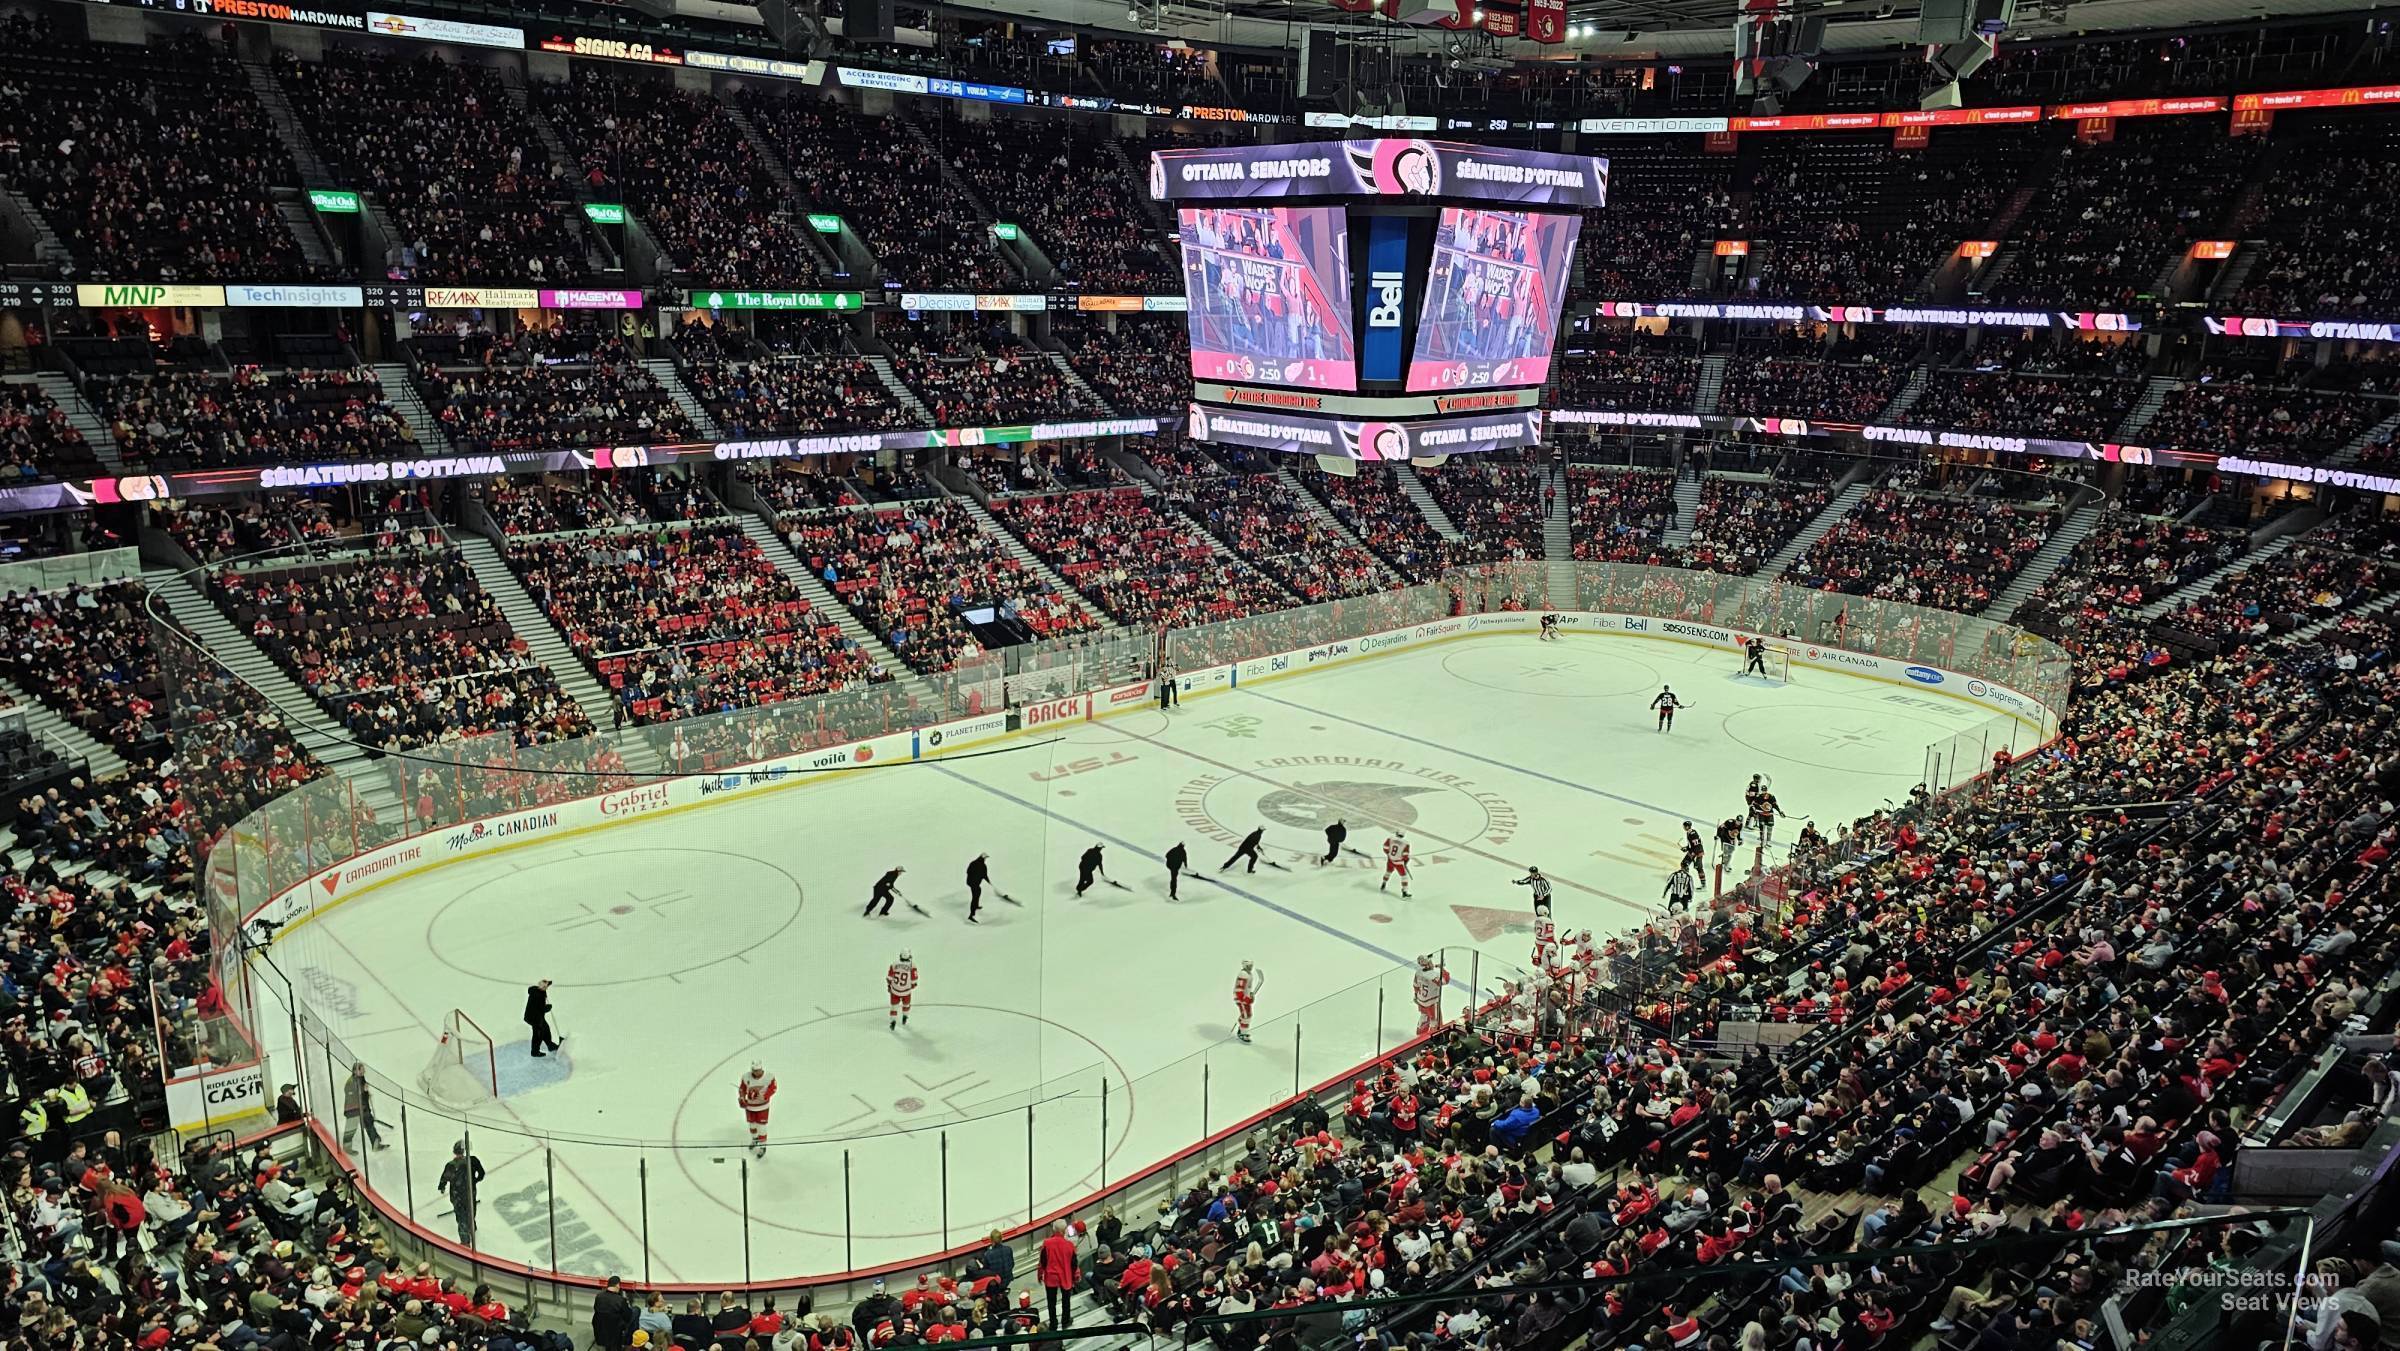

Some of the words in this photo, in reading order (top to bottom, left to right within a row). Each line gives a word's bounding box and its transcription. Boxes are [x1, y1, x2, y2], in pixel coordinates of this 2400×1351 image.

[291, 10, 363, 28] HARDWARE
[574, 36, 653, 61] SIGNS.CA
[846, 70, 876, 79] ACCESS
[877, 73, 912, 83] RIGGING
[860, 78, 898, 88] SERVICES
[1193, 106, 1246, 122] PRESTON
[1584, 120, 1724, 132] LIVENATION.com
[1182, 162, 1245, 182] OTTAWA
[1250, 158, 1331, 180] SENATORS
[1456, 158, 1524, 184] SÉNATEURS
[1524, 169, 1584, 188] D'OTTAWA
[0, 285, 19, 294] 319
[51, 285, 72, 294] 320
[104, 286, 166, 305] MNP
[243, 287, 347, 304] TechInsights
[366, 288, 383, 296] 320
[406, 288, 421, 296] 321
[427, 290, 481, 306] RE/MAX
[485, 290, 535, 300] Hallmark
[570, 292, 626, 303] MAGENTA
[2, 297, 21, 306] 219
[53, 297, 73, 306] 220
[367, 299, 384, 307] 220
[407, 299, 422, 307] 221
[485, 299, 511, 308] Realty
[513, 300, 536, 309] Group
[735, 292, 760, 306] The
[763, 293, 797, 309] Royal
[799, 293, 823, 307] Oak
[919, 295, 970, 309] Decisive
[978, 295, 1013, 309] RE/MAX
[1369, 271, 1403, 328] Bell
[1655, 303, 1721, 318] OTTAWA
[1725, 304, 1804, 320] SENATORS
[1884, 307, 1967, 325] SÉNATEURS
[1968, 311, 2050, 327] D'OTTAWA
[2310, 321, 2393, 341] OTTAWA
[1226, 359, 1235, 375] 0
[1259, 366, 1281, 382] 2:50
[1308, 366, 1316, 381] 1
[1442, 367, 1450, 383] 0
[1470, 371, 1489, 384] 2:50
[1511, 366, 1518, 380] 1
[1549, 409, 1626, 425] SÉNATEURS
[1626, 412, 1702, 428] D'OTTAWA
[1031, 421, 1099, 440] SÉNATEURS
[1099, 418, 1158, 435] D'OTTAWA
[1210, 416, 1270, 440] SÉNATEURS
[1270, 423, 1333, 446] D'OTTAWA
[1420, 428, 1467, 447] OTTAWA
[1470, 423, 1524, 442] SENATORS
[715, 439, 792, 460] OTTAWA
[797, 434, 882, 456] SENATORS
[1862, 426, 1933, 445] OTTAWA
[1939, 432, 2027, 453] SENATORS
[260, 461, 388, 488] SÉNATEURS
[391, 455, 506, 480] D'OTTAWA
[2217, 455, 2314, 482] SÉNATEURS
[1426, 623, 1461, 637] FairSquare
[1625, 617, 1648, 631] Bell
[1663, 622, 1729, 643] 5050SENS.COM
[1371, 633, 1407, 648] Desjardins
[1271, 655, 1289, 672] Bell
[1821, 652, 1838, 661] AIR
[1838, 655, 1879, 669] CANADA
[1989, 687, 2024, 709] Supreme
[1028, 699, 1079, 726] BRICK
[945, 723, 974, 739] PLANET
[974, 719, 1004, 734] FITNESS
[812, 752, 846, 768] voilà
[600, 783, 668, 816] Gabriel
[622, 799, 670, 815] PIZZA
[446, 828, 493, 850] Molson
[498, 812, 558, 837] CANADIAN
[1390, 845, 1399, 857] 8
[346, 855, 397, 885] CANADIAN
[399, 846, 422, 865] TIRE
[893, 971, 908, 987] 59
[206, 1077, 239, 1090] RIDEAU
[1262, 1220, 1281, 1245] H
